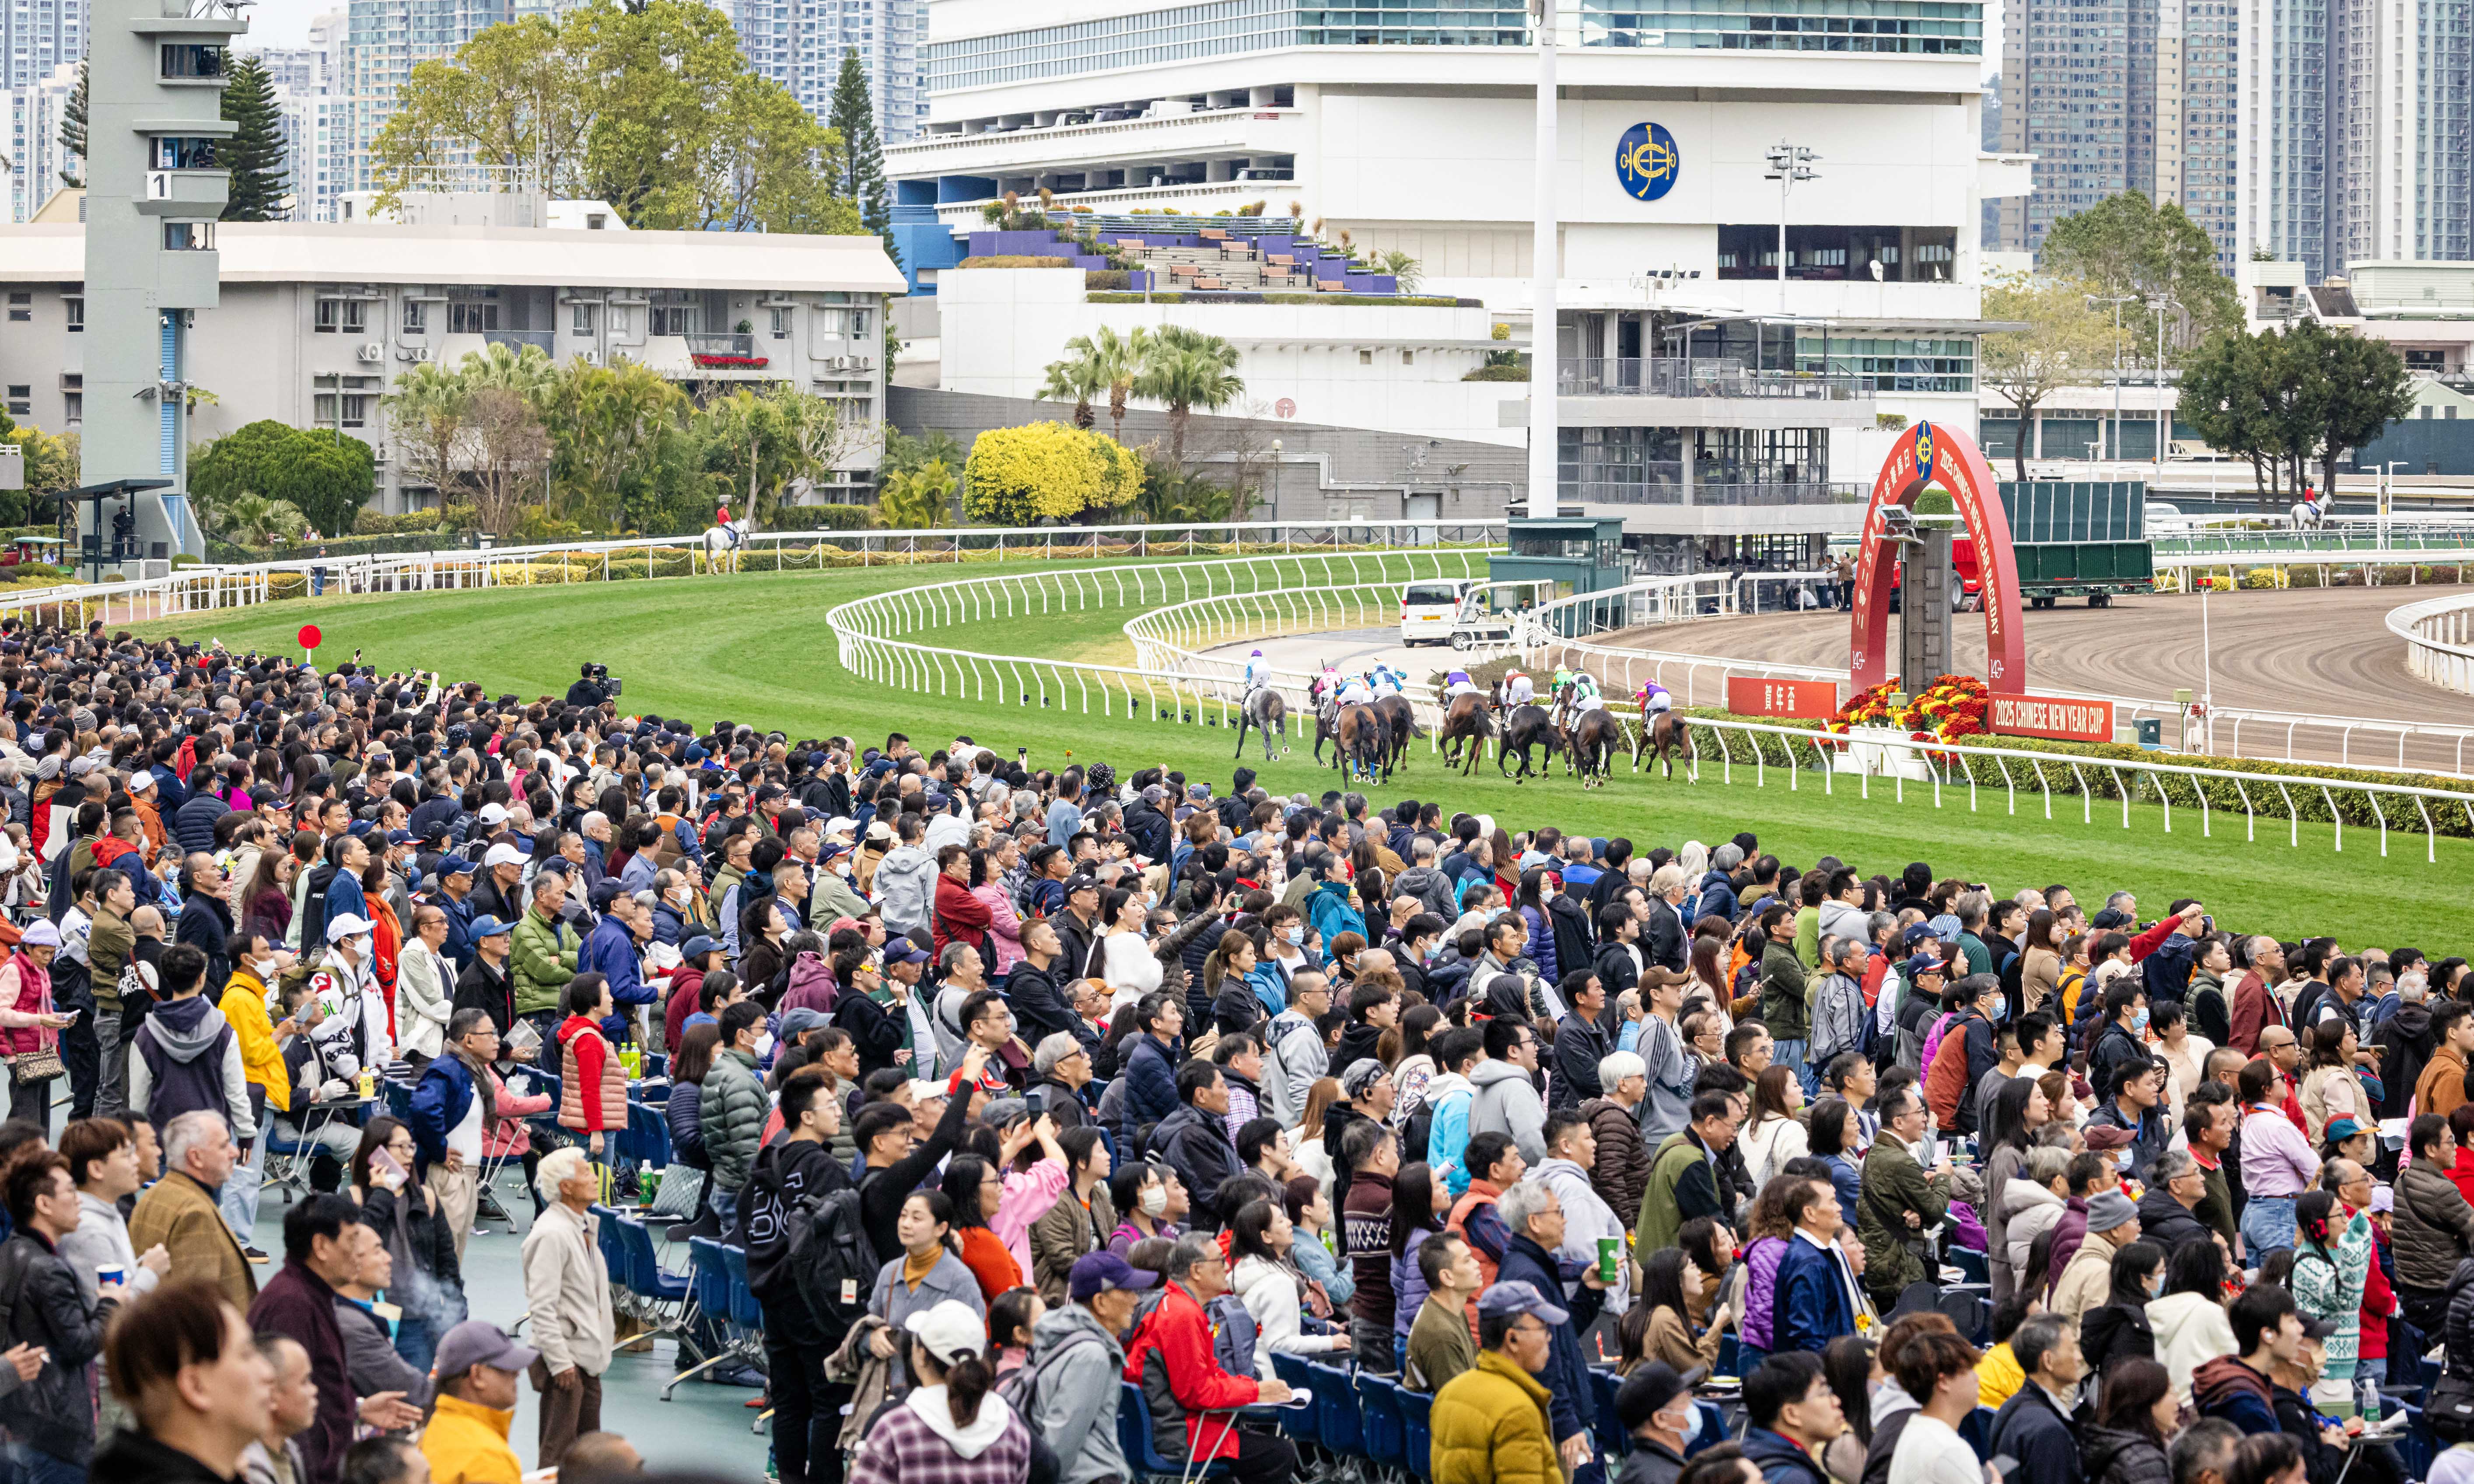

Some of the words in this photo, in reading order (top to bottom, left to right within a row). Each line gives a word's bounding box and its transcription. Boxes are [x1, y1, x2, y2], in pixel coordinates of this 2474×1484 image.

[154, 174, 164, 197] 1
[1940, 447, 1953, 476] 2025
[1953, 462, 1973, 511] CHINESE
[1970, 500, 1982, 535] NEW
[1978, 529, 1990, 570] YEAR
[1985, 567, 1999, 635] RACEDAY
[1765, 684, 1795, 712] 賀年盃
[1995, 699, 2015, 727] 2025
[2016, 701, 2047, 730] CHINESE
[2049, 704, 2066, 731] NEW
[2066, 705, 2087, 733] YEAR
[2089, 707, 2104, 734] CUP
